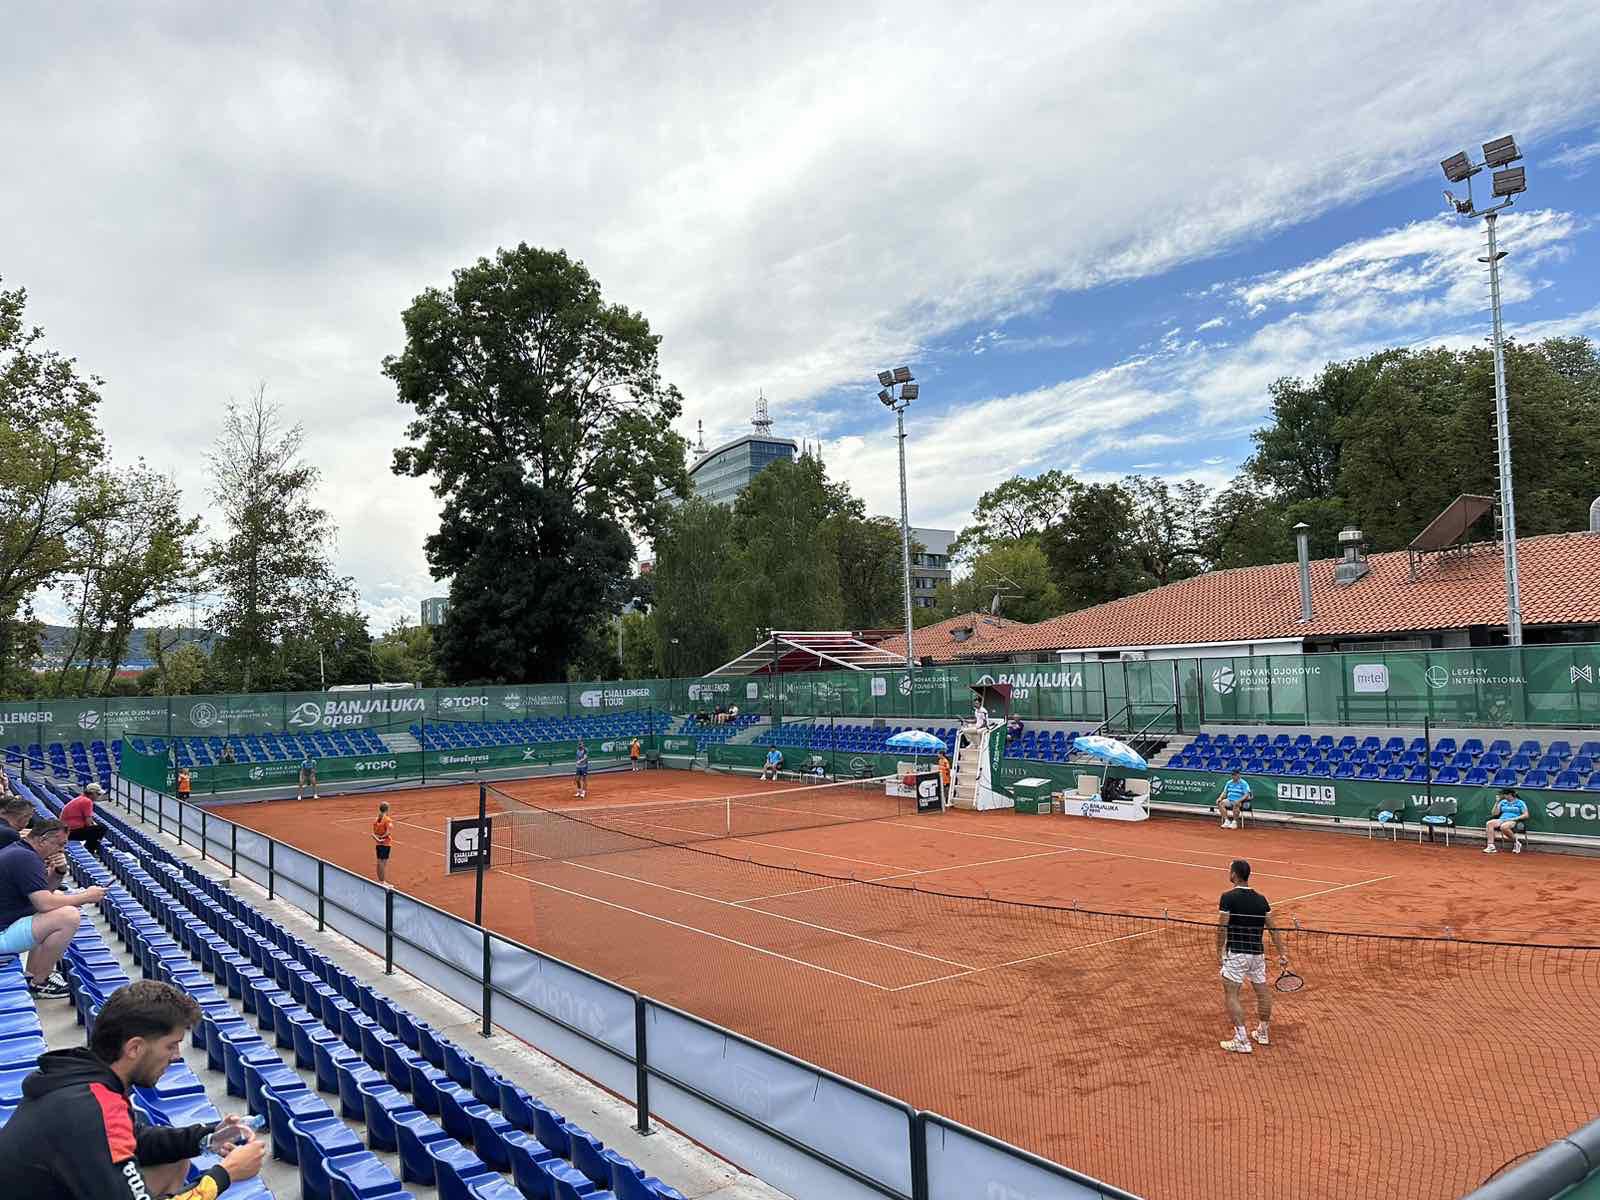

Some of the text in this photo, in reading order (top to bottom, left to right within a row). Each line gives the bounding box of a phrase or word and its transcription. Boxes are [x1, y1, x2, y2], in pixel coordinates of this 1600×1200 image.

[1240, 666, 1321, 676] NOVAK DJOKOVIC
[1451, 668, 1488, 676] LEGACY
[998, 672, 1083, 688] BANJALUKA
[1451, 676, 1528, 685] INTERNATIONAL
[603, 688, 650, 698] CHALLENGER
[324, 698, 425, 715] BANJALUKA
[453, 696, 489, 707] TCPC
[604, 697, 624, 707] TOUR
[322, 714, 363, 728] open
[364, 759, 398, 771] TCPC
[1565, 802, 1600, 820] TC
